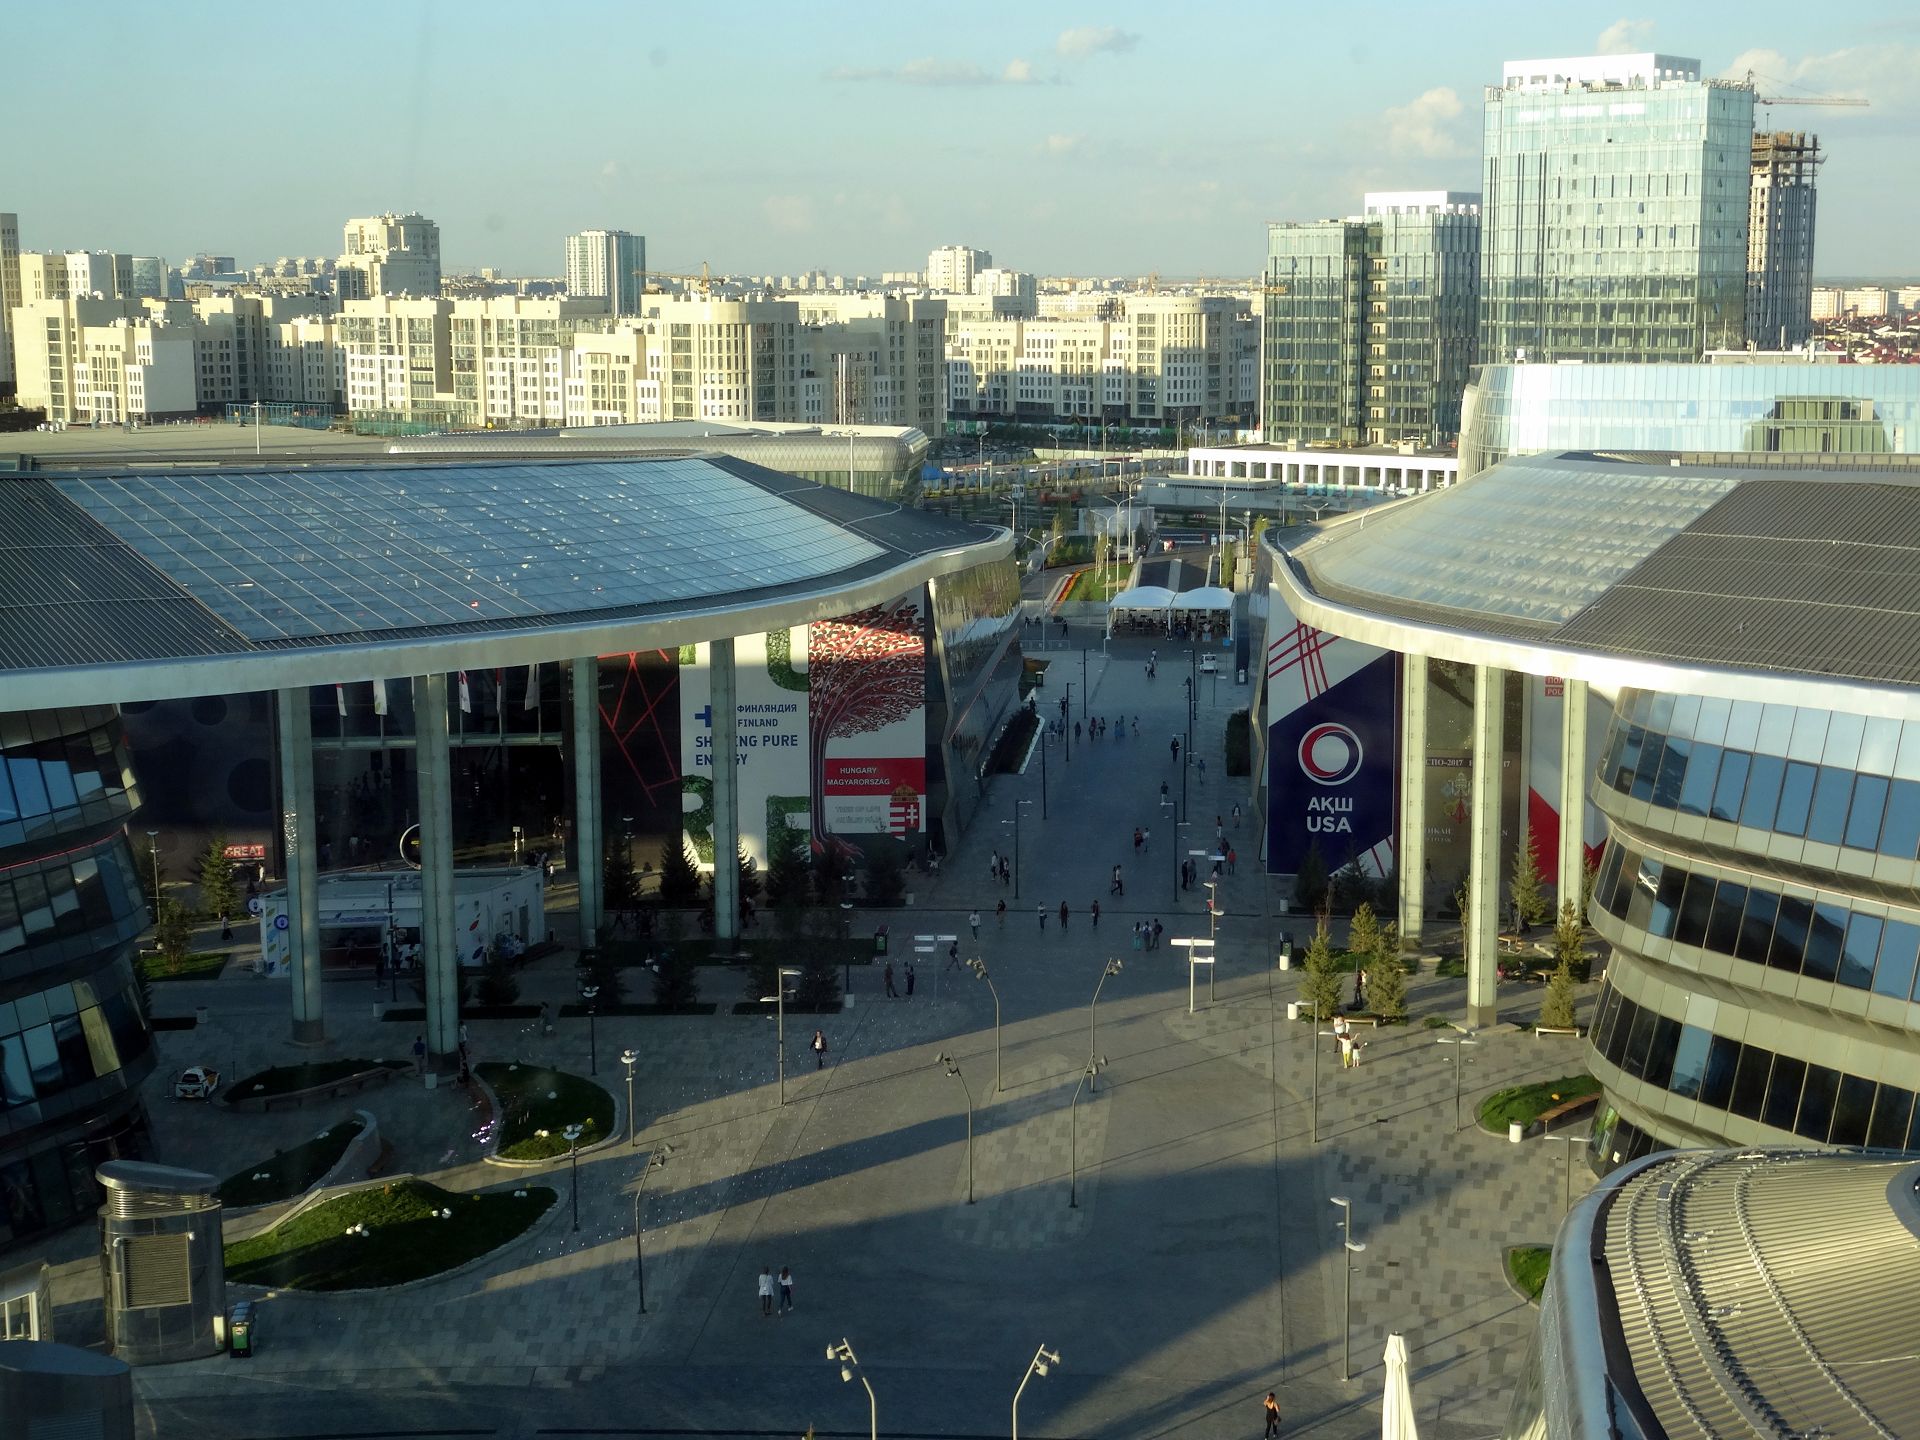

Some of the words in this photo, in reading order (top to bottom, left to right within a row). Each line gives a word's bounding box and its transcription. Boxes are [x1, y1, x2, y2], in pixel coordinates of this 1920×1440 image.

[736, 703, 798, 713] ФИНЛЯНДИЯ
[737, 718, 779, 728] FINLAND
[695, 735, 758, 748] SHNG
[762, 734, 799, 747] PURE
[695, 753, 748, 766] ENY
[1307, 796, 1353, 814] АҚШ
[1306, 816, 1353, 833] USA
[225, 845, 264, 856] GREAT
